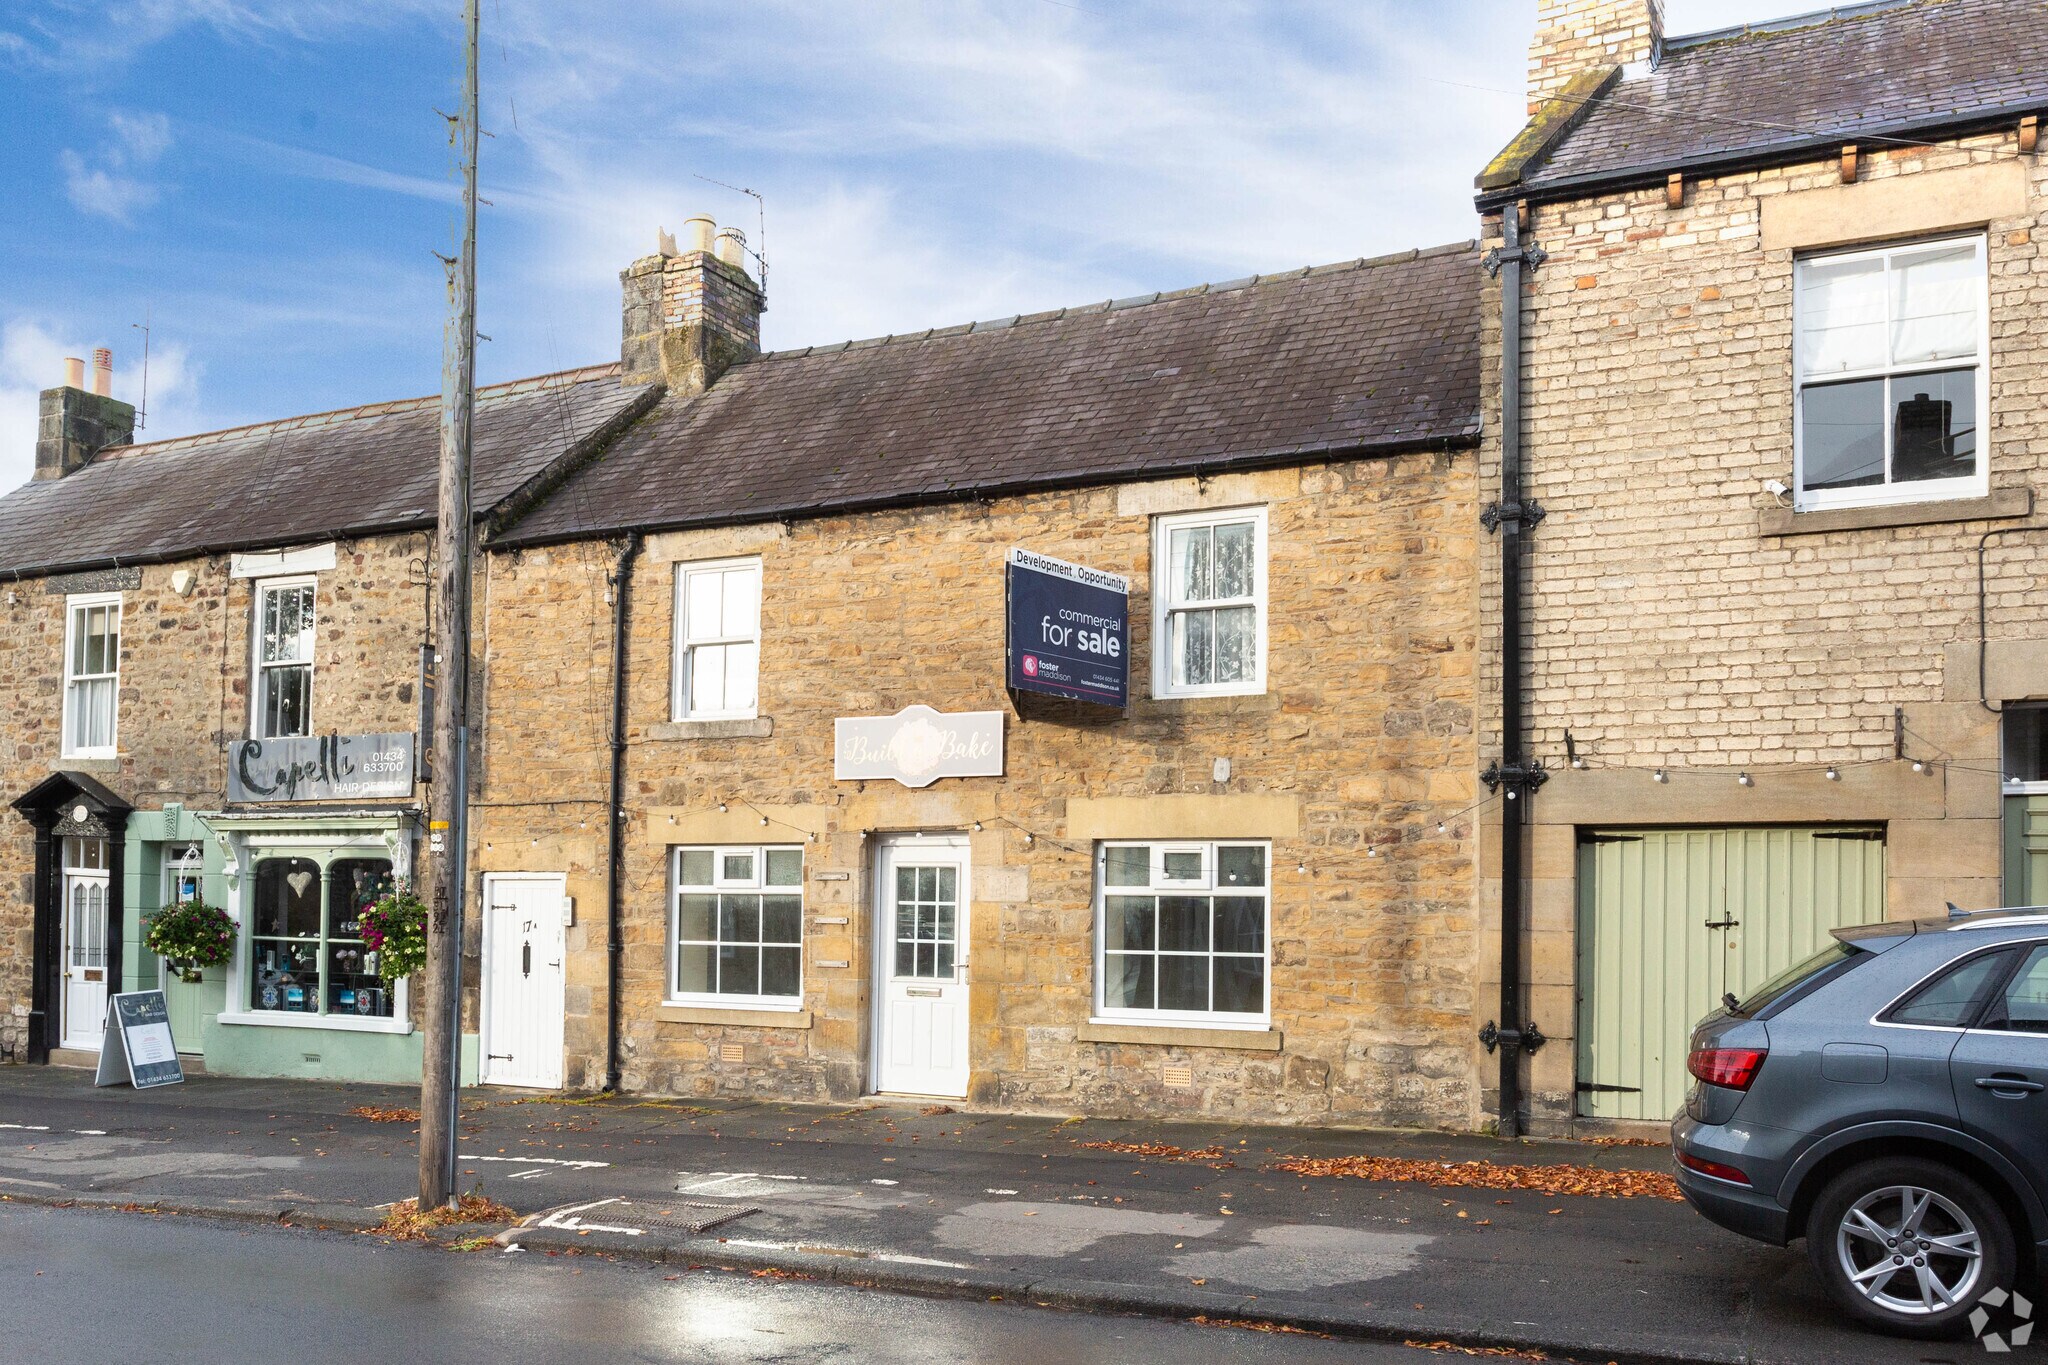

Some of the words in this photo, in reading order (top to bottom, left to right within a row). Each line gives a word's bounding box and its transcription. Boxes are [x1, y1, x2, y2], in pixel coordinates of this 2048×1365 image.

[1016, 550, 1073, 577] Development
[1078, 567, 1127, 592] Opportunity
[1059, 608, 1121, 632] commercial
[1041, 615, 1072, 647] for
[1077, 628, 1121, 658] sale
[1039, 660, 1059, 671] foster
[1039, 669, 1072, 682] maddison
[937, 730, 994, 760] Bake
[239, 734, 355, 800] Capelli
[363, 762, 404, 772] 633700
[372, 751, 404, 762] 01434
[334, 782, 359, 793] HAIR
[362, 781, 403, 792] DESIGN
[121, 996, 165, 1017] Capelli
